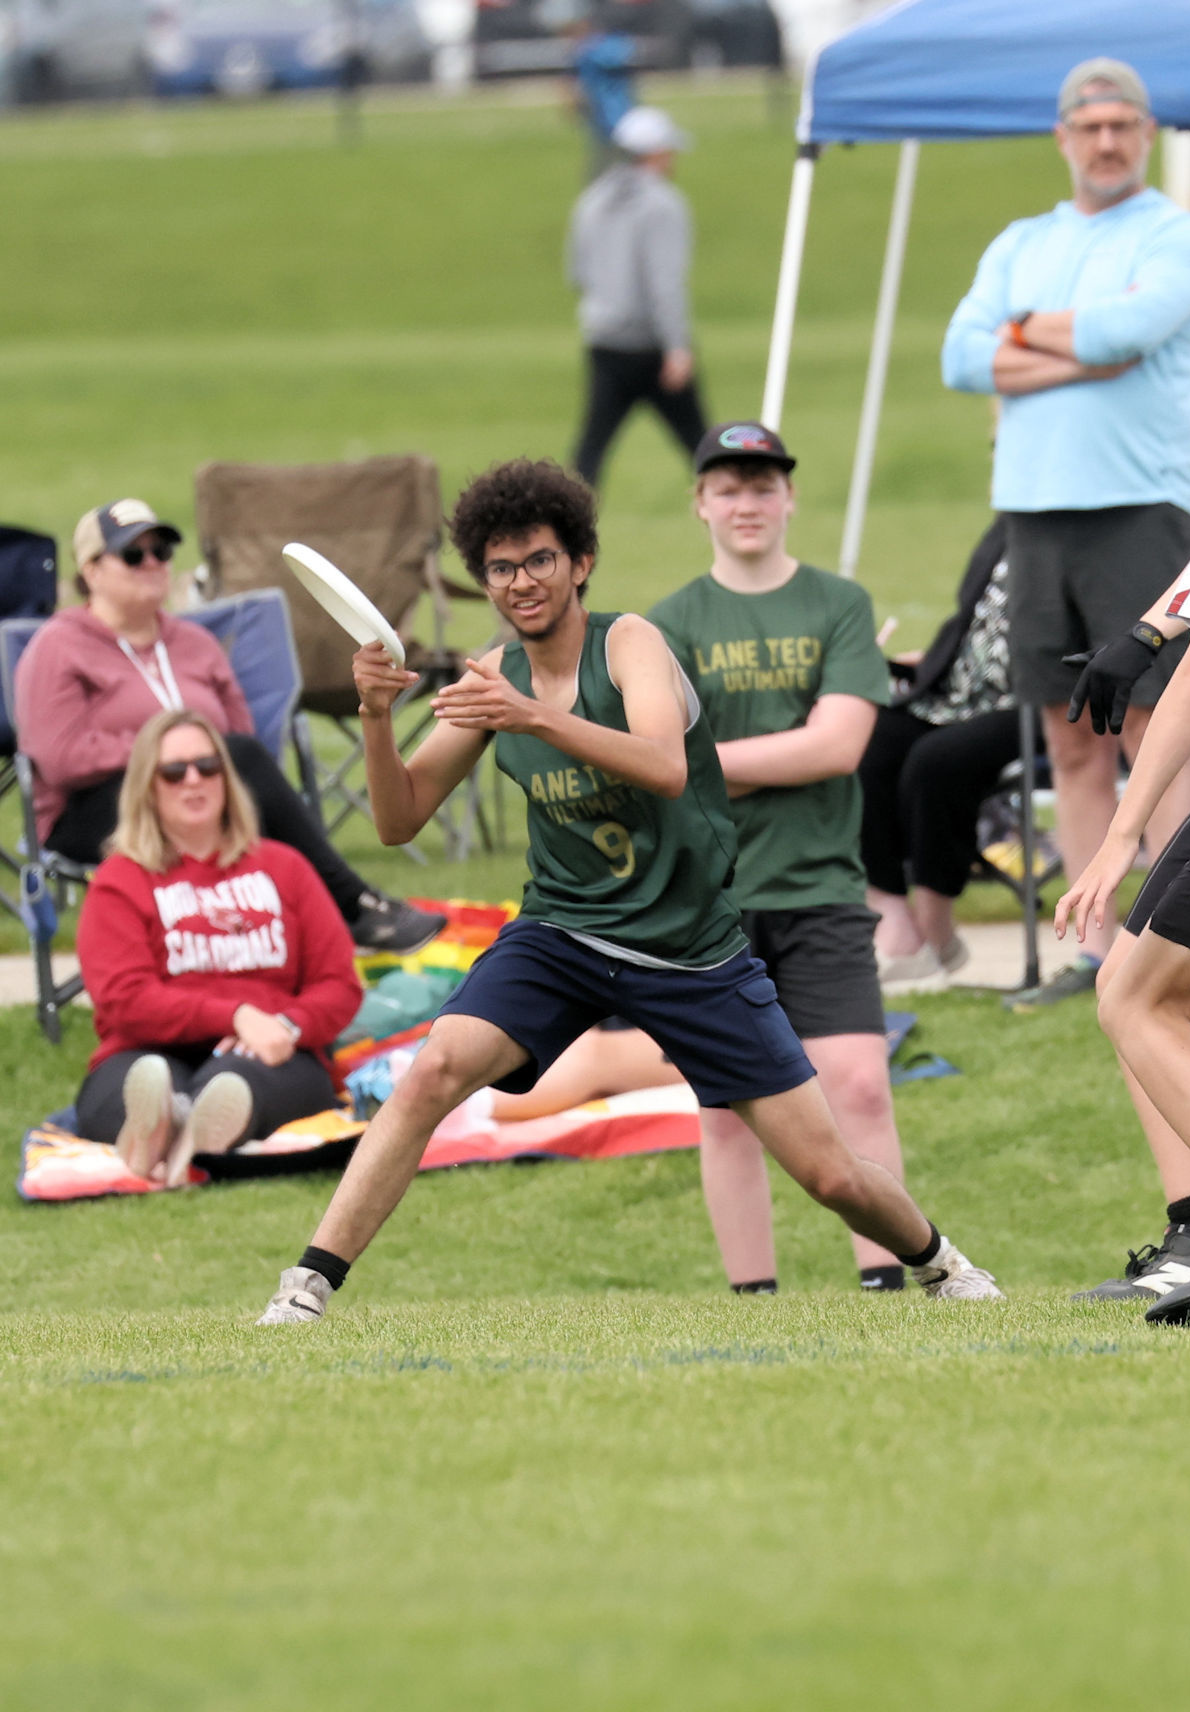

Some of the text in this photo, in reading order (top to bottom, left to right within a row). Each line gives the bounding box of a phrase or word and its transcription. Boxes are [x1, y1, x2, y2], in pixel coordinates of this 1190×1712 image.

[694, 638, 760, 677] LANE
[723, 667, 810, 693] ULTIMATE
[530, 766, 582, 804] ANE
[591, 820, 636, 879] 9
